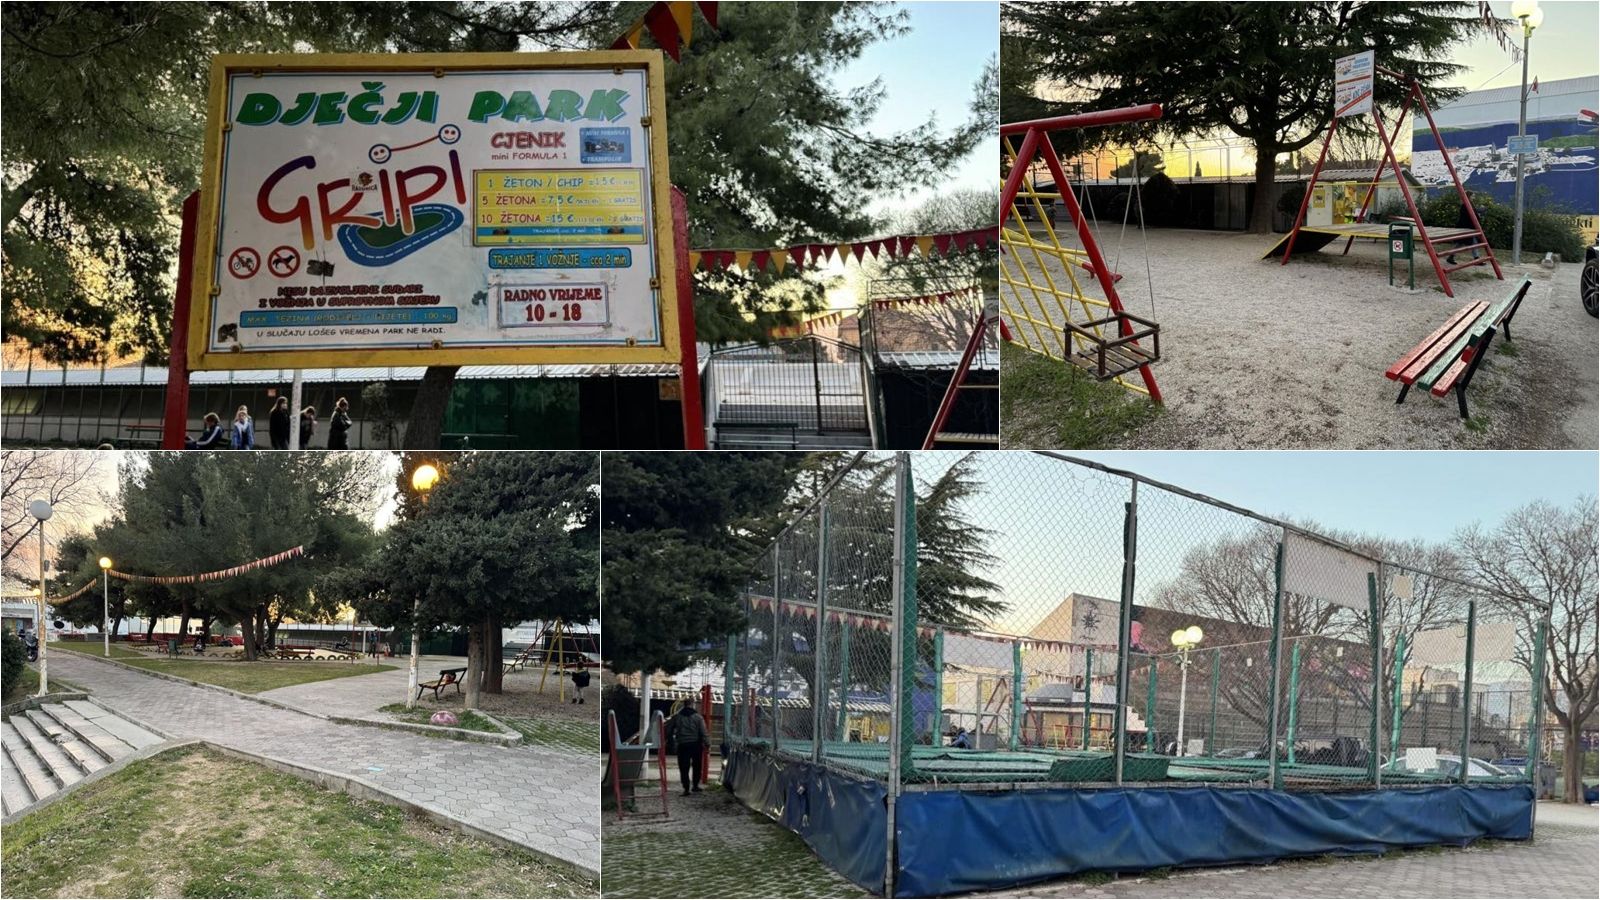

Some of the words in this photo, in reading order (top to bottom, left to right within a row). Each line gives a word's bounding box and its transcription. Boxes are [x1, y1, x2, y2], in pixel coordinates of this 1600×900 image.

[236, 82, 440, 126] DJEČJI
[467, 88, 631, 123] PARK
[490, 131, 567, 150] CJENIK
[491, 152, 509, 160] mini
[512, 152, 558, 160] FORMULA
[488, 179, 493, 187] 1
[503, 176, 543, 187] ŽETON
[557, 177, 584, 187] CHIP
[482, 196, 489, 205] 5
[496, 193, 537, 204] ŽETONA
[481, 214, 493, 223] 10
[500, 211, 541, 223] ŽETONA
[492, 254, 537, 266] TRAJANJE
[546, 250, 580, 266] VOŽNJE
[590, 256, 603, 264] cca
[605, 254, 611, 264] 2
[613, 256, 628, 265] min
[277, 286, 308, 297] NISU
[310, 284, 379, 296] DOZVOLJENI
[381, 284, 423, 295] SUDARI
[503, 289, 547, 302] RADNO
[548, 288, 603, 301] VRIJEME
[316, 297, 326, 306] U
[328, 296, 395, 307] SUPROTNOM
[397, 295, 441, 306] SMJERU
[525, 304, 545, 322] 10
[562, 303, 582, 321] 18
[266, 329, 305, 337] SLUČAJU
[308, 328, 336, 336] LOŠEG
[339, 328, 379, 336] VREMENA
